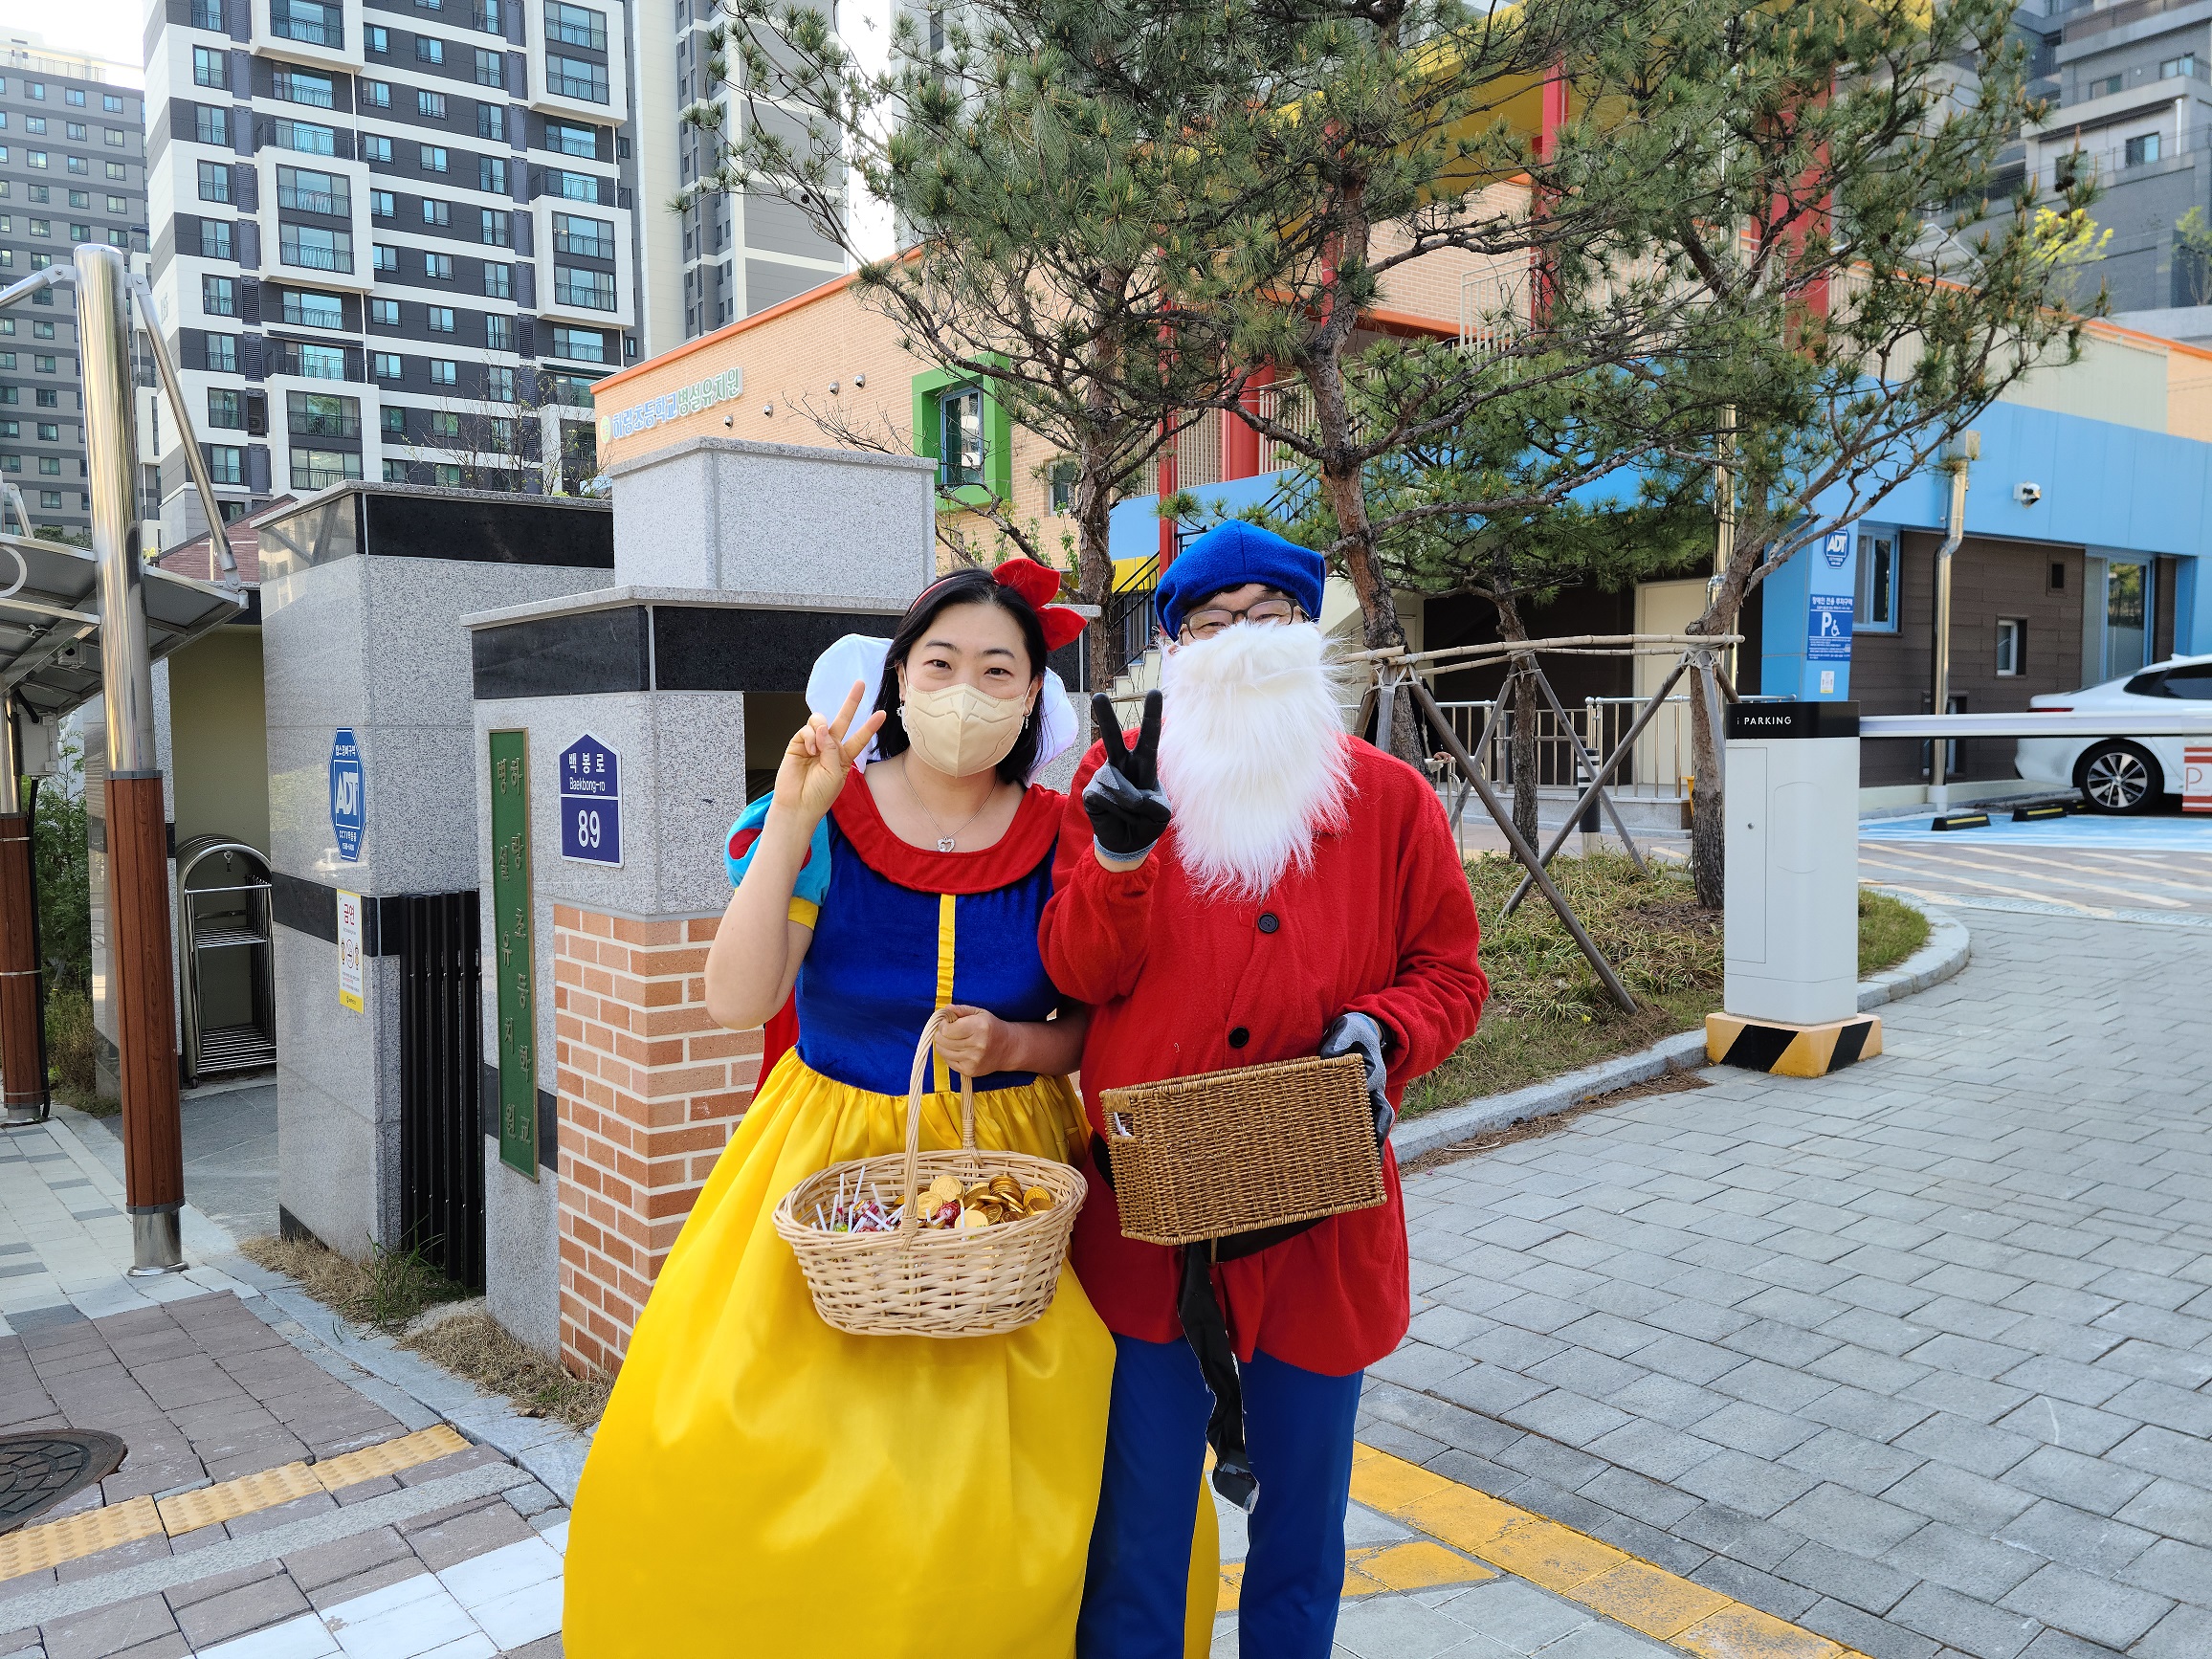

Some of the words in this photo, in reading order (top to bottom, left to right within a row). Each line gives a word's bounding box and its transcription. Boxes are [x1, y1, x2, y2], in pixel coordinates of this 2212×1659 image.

[1827, 535, 1847, 552] ADT
[1822, 612, 1832, 636] P
[1744, 717, 1792, 725] PARKING
[568, 752, 606, 774] 백봉로
[336, 771, 359, 816] ADT
[569, 776, 606, 793] Baekbong-ro
[578, 809, 601, 849] 89
[343, 902, 355, 925] 금연
